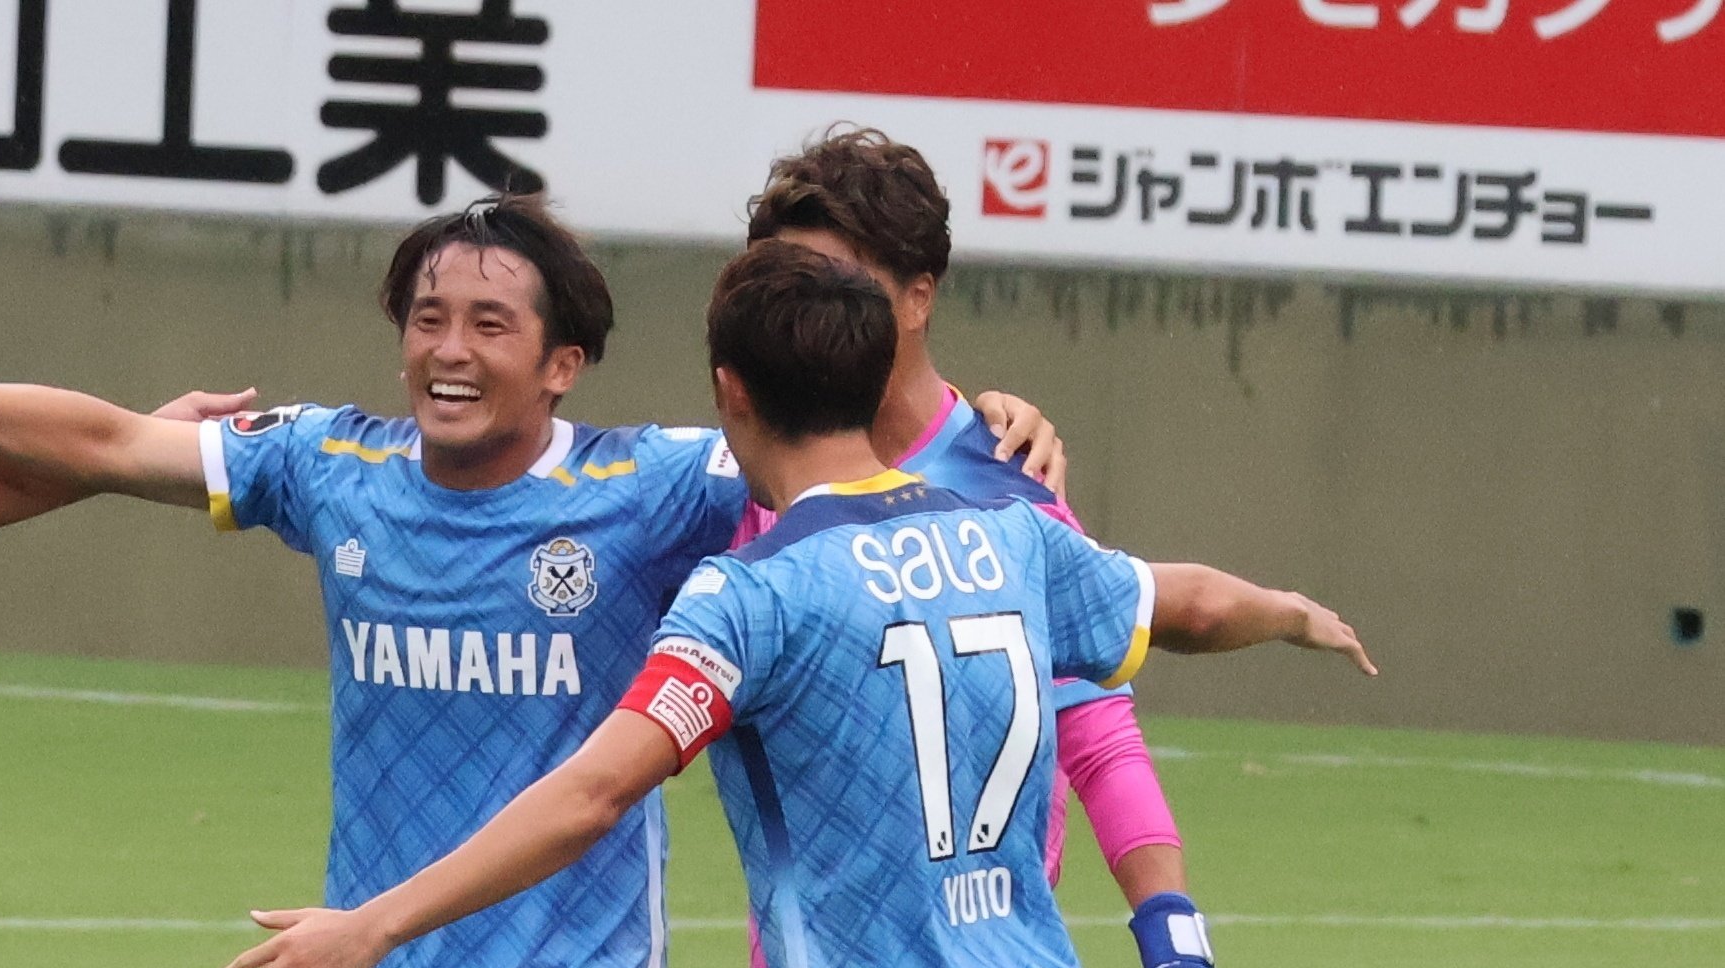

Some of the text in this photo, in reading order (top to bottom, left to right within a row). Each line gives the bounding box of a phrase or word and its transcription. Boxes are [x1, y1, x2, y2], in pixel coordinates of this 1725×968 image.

[851, 519, 1006, 604] sala
[341, 618, 582, 697] YAMAHA
[876, 610, 1043, 862] 17
[943, 866, 1012, 927] YUTO
